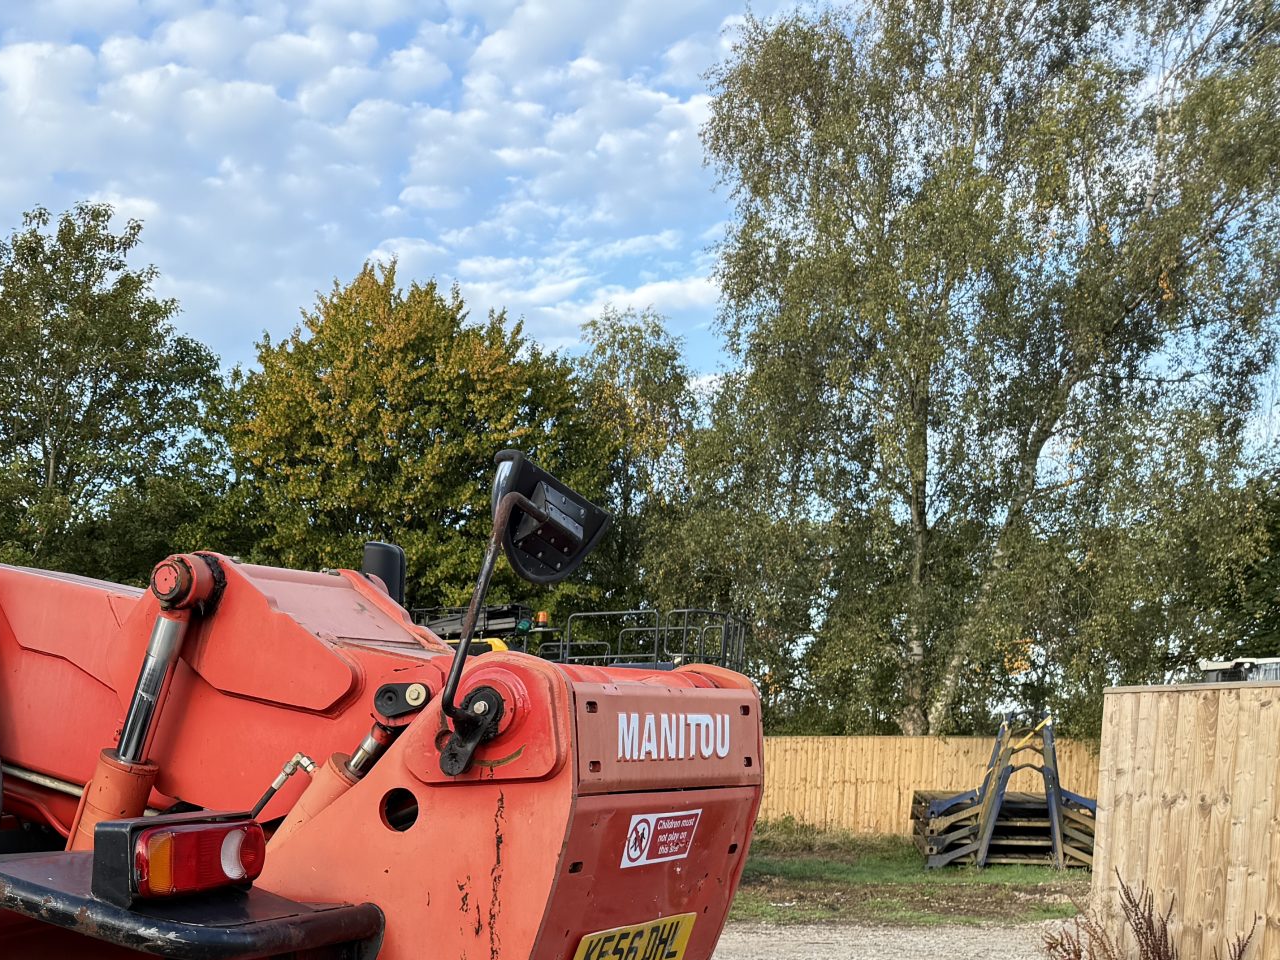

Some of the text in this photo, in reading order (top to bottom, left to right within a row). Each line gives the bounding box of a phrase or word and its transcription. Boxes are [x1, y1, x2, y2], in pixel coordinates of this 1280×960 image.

[617, 711, 730, 761] MANITOU
[658, 817, 695, 830] Children must
[657, 831, 688, 844] not play on
[658, 844, 669, 855] this
